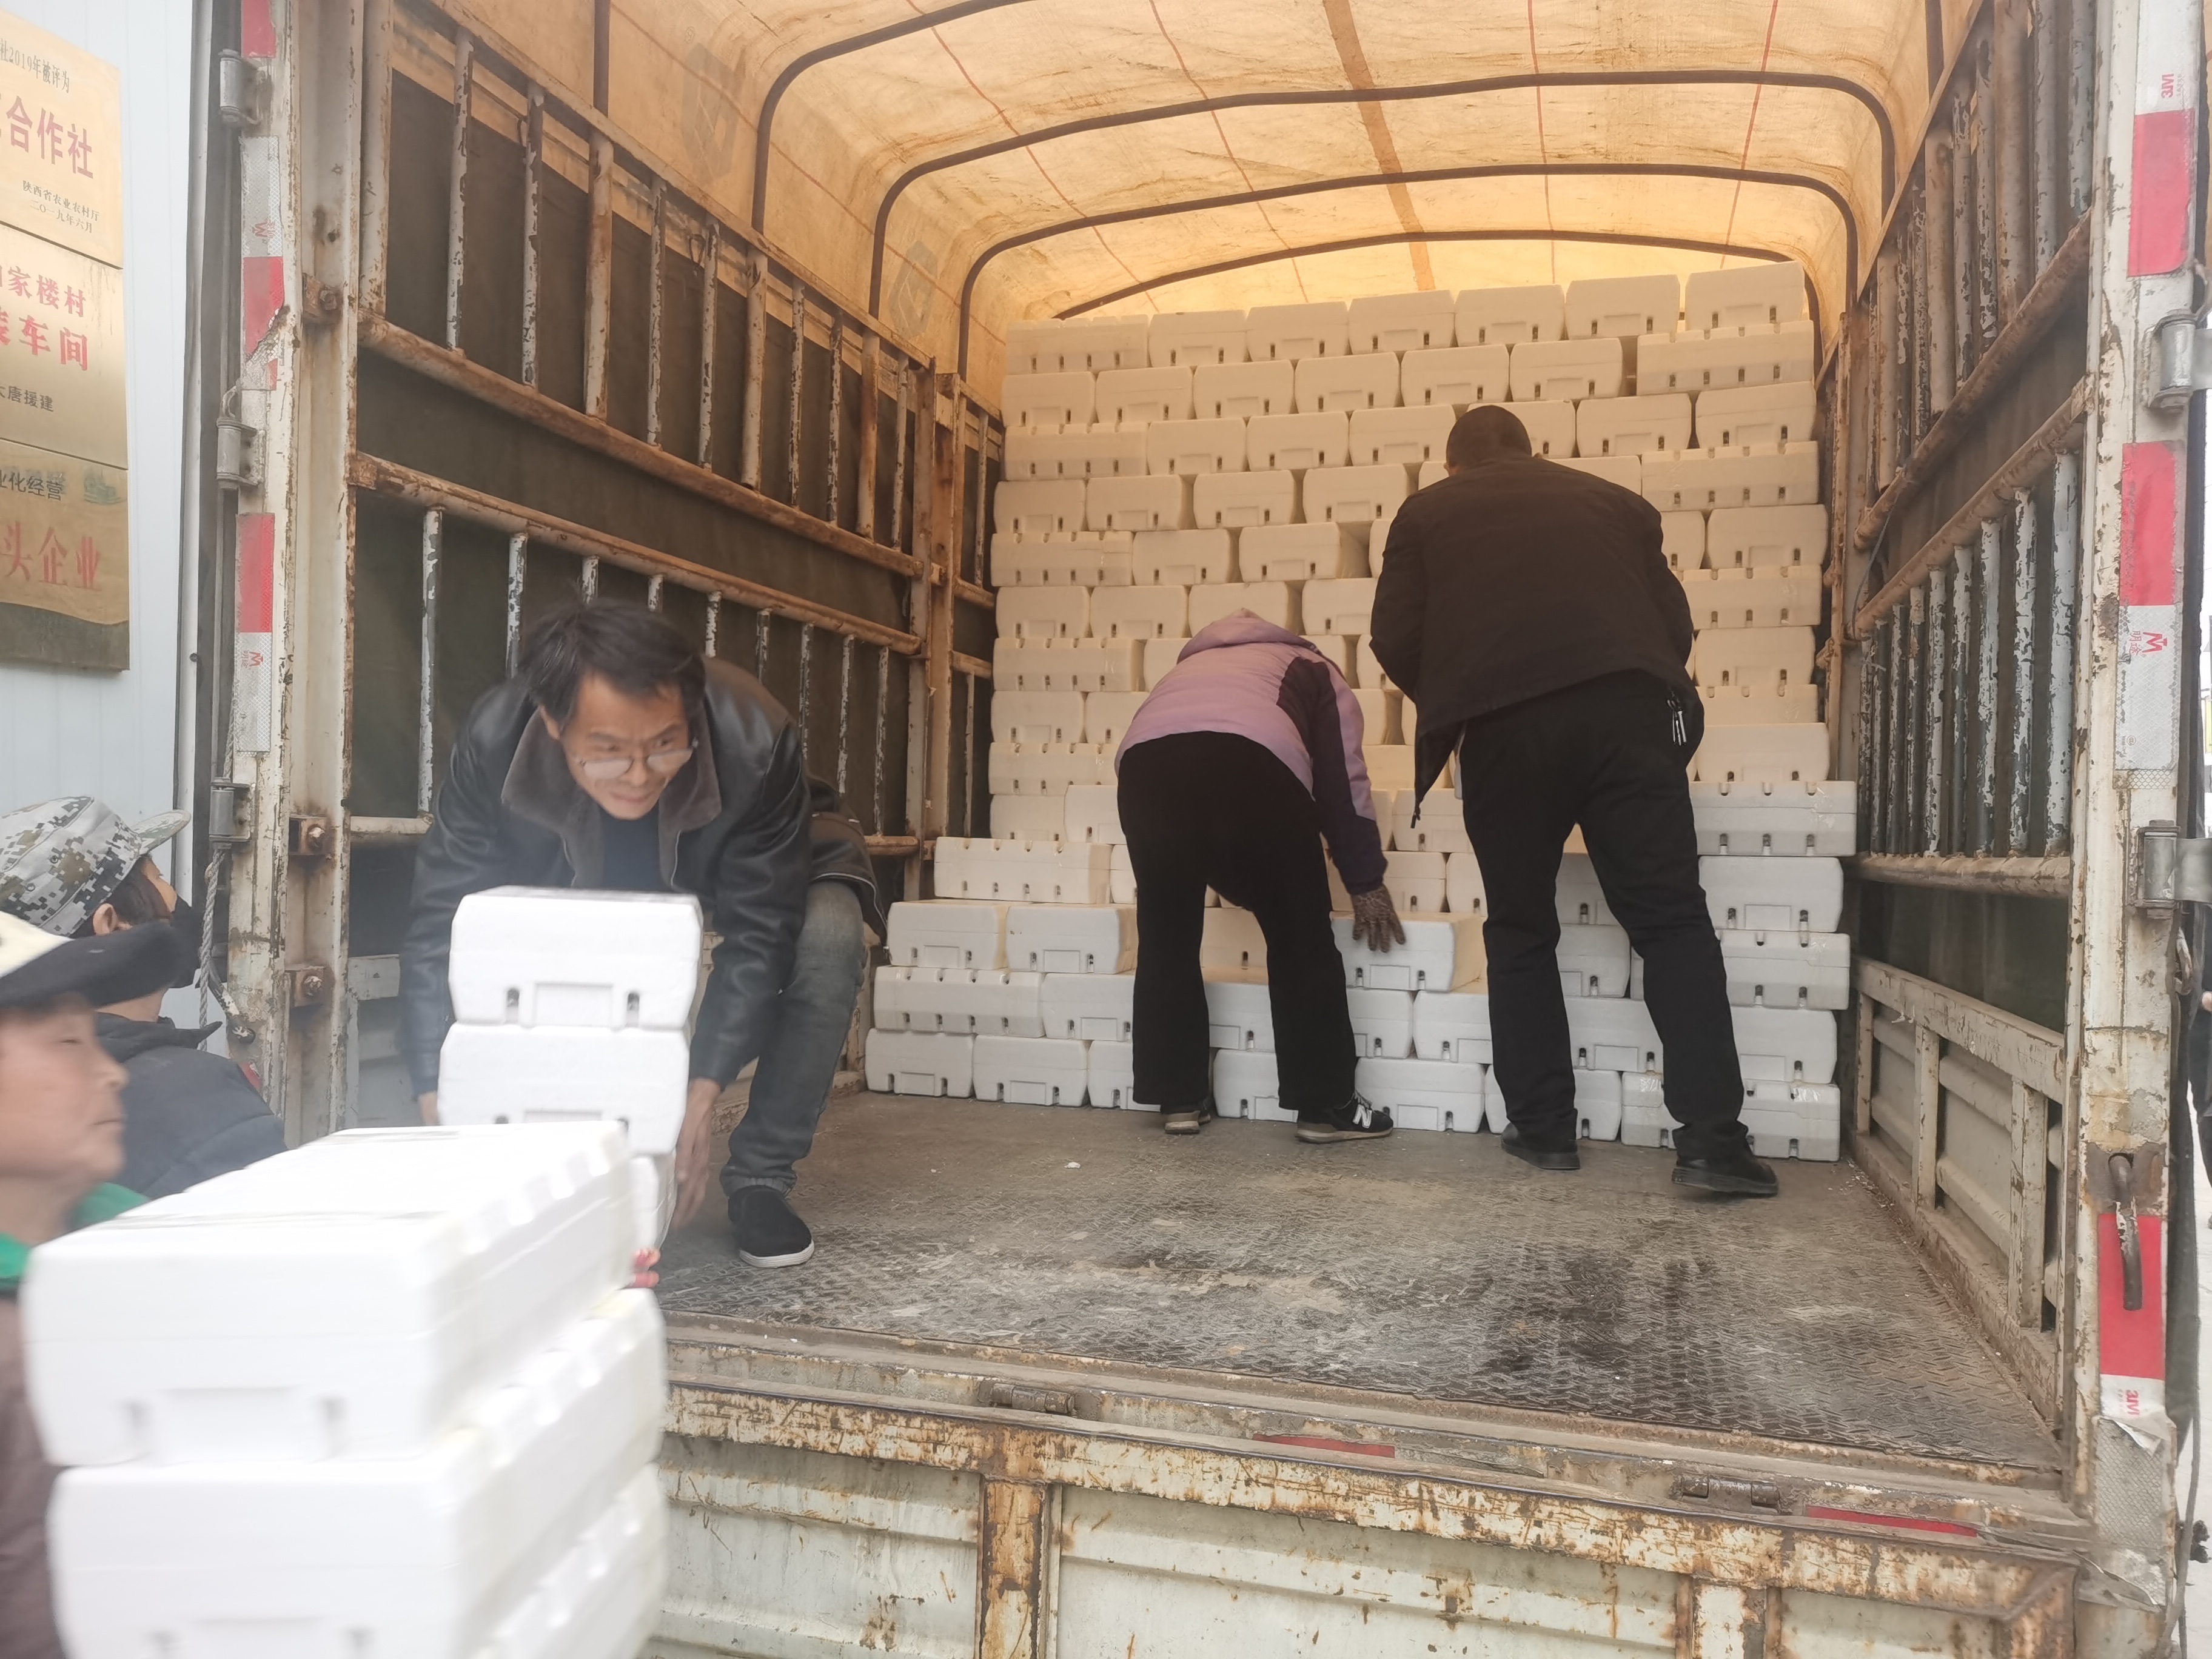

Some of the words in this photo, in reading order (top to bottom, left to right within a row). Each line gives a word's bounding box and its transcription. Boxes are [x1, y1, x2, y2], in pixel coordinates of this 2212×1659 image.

[2161, 73, 2174, 98] 3M
[0, 94, 93, 179] 合作社
[22, 180, 99, 221] 陕西省农业农村厅
[0, 264, 86, 318] 家楼村
[0, 520, 102, 592] 头企业
[2128, 631, 2142, 656] 明途
[1352, 1104, 1373, 1128] N
